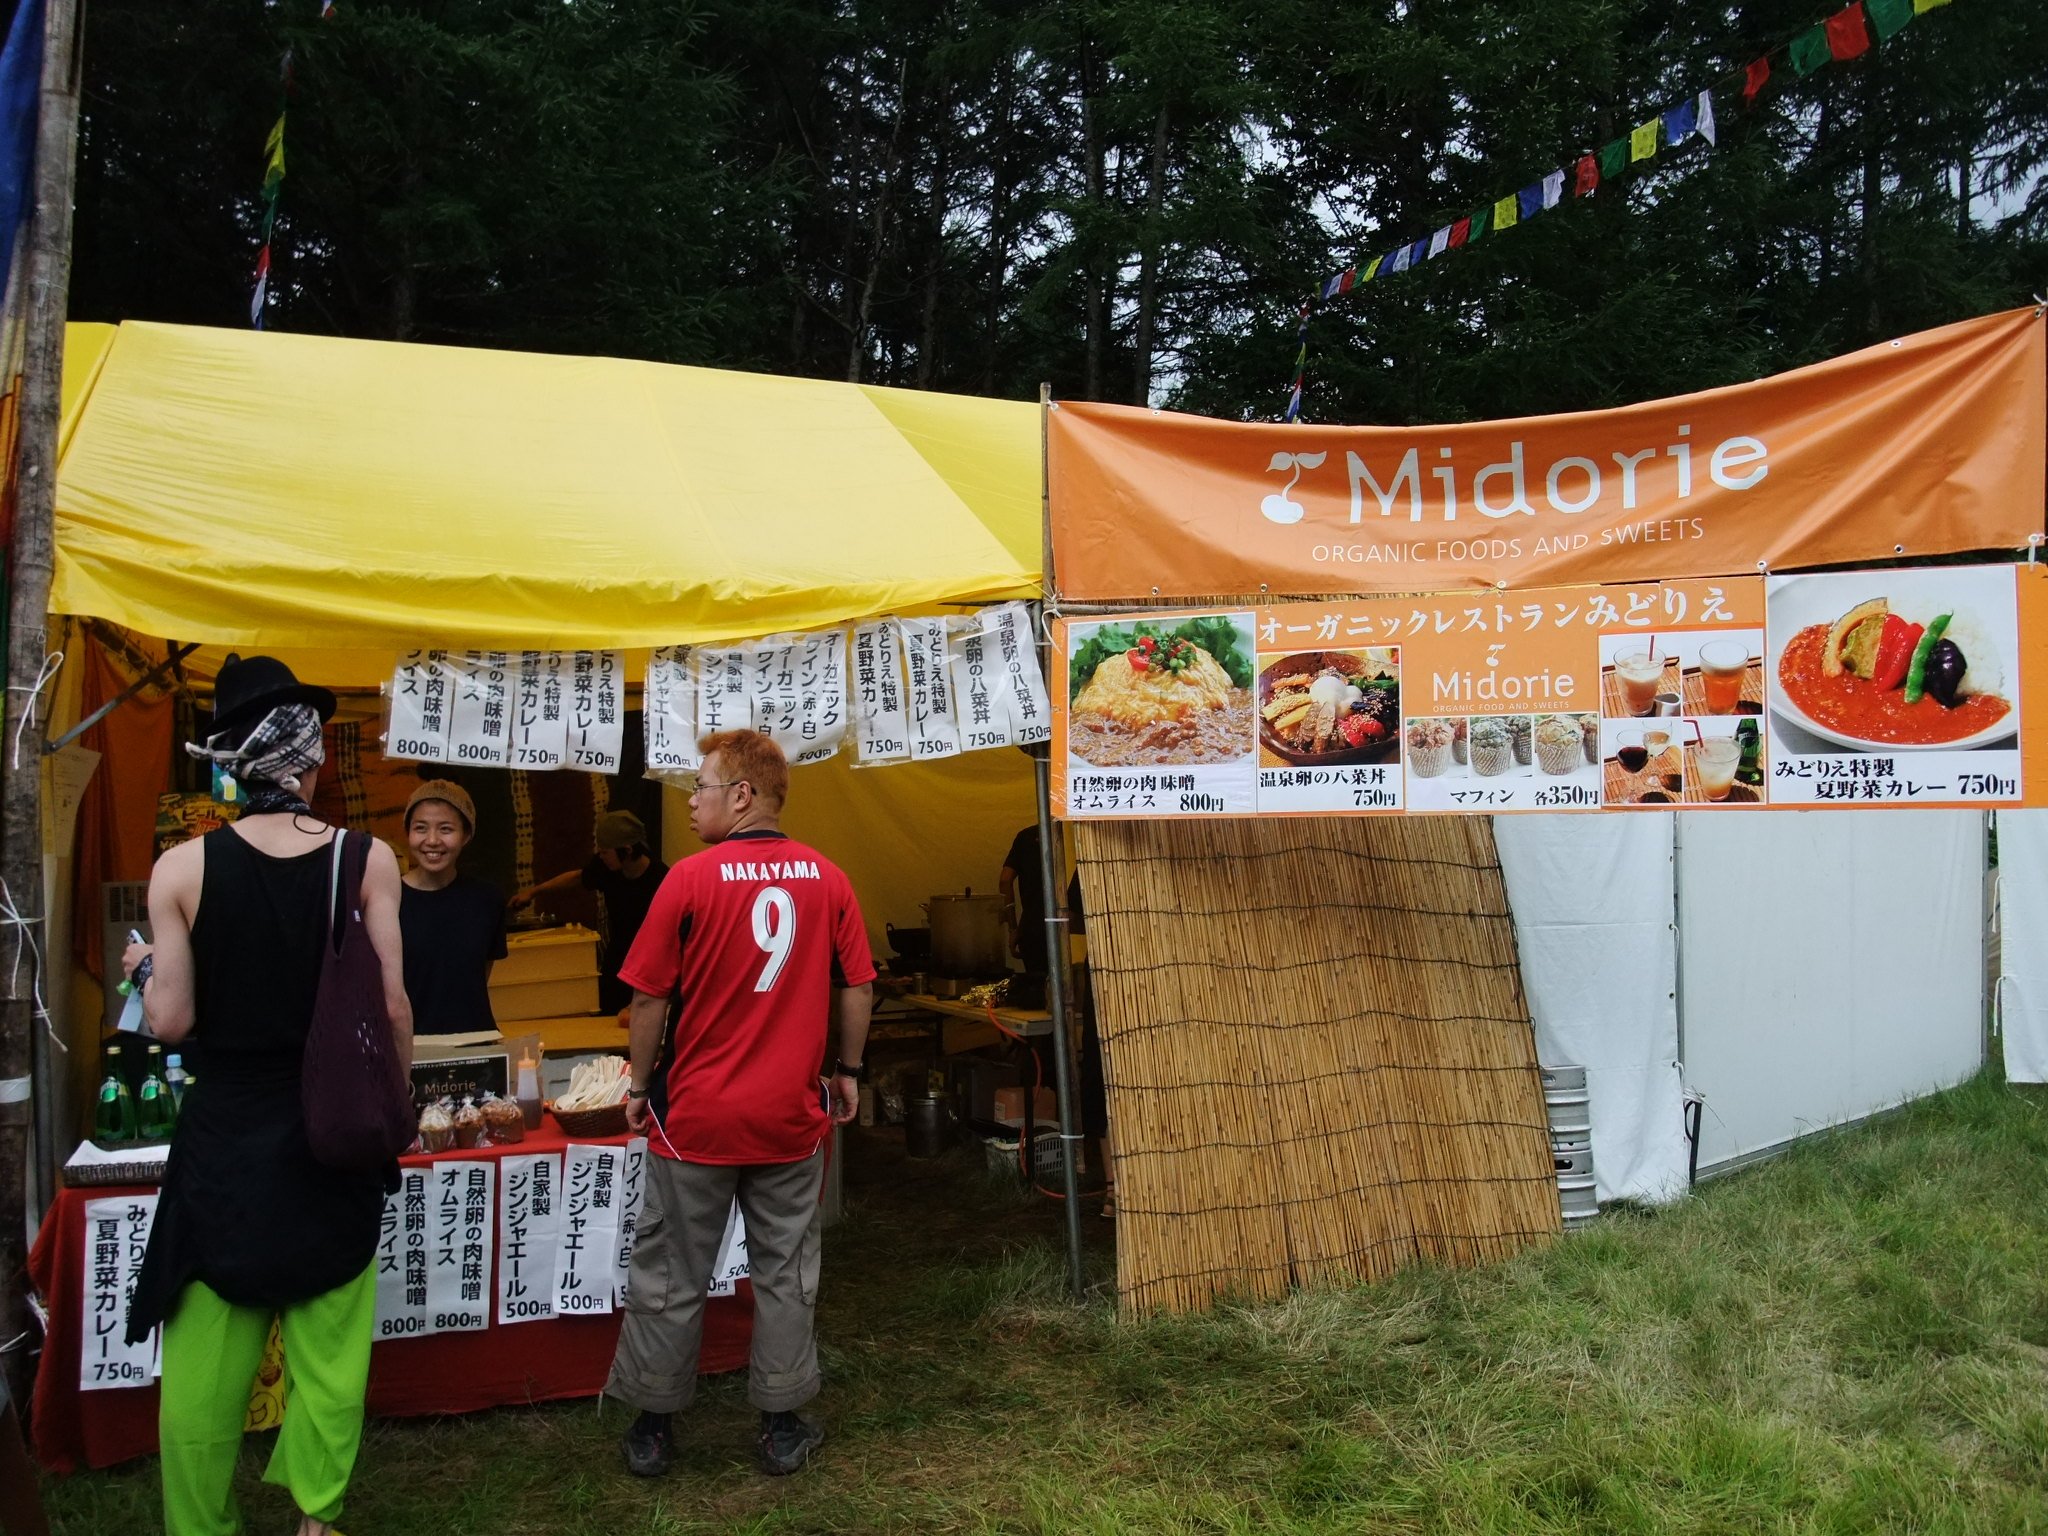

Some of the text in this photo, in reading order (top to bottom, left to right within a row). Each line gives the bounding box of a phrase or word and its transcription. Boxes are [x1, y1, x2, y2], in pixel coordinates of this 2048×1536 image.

[1346, 424, 1769, 524] Midorie
[1311, 517, 1704, 563] ORGANIC FOODS AND SWEETS
[1257, 586, 1735, 644] オーガニックレストランみどりえ
[998, 612, 1037, 721] 温泉卵の八菜丼
[543, 650, 562, 721] りえ特製
[777, 645, 797, 731] オーガニック
[821, 633, 841, 727] オーガニック
[1431, 668, 1575, 702] Midorie
[574, 650, 594, 747] 野菜カレー
[1432, 701, 1570, 713] ORGANIC FOOD AND SWEETS
[396, 739, 440, 758] 800円
[865, 739, 903, 754] 750円
[918, 740, 953, 754] 750円
[968, 731, 1006, 747] 750円
[457, 743, 501, 761] 800円
[517, 748, 559, 764] 750円
[574, 750, 615, 767] 750円
[654, 752, 692, 767] 500円
[1259, 767, 1386, 788] 温泉卵の八菜丼
[1775, 758, 1895, 778] みどりえ特製
[1072, 773, 1196, 793] 自然卵の肉味噌
[1814, 773, 2016, 800] 夏野菜カレー 750円
[1072, 793, 1224, 812] オムライス 800円
[1353, 788, 1397, 807] 750円
[1450, 784, 1599, 806] マフィン 各350円
[720, 860, 821, 882] NAKAYAMA
[751, 886, 797, 992] 9
[424, 1080, 477, 1095] Midorie
[532, 1160, 550, 1217] 自家製
[593, 1152, 615, 1209] 自家製
[437, 1168, 461, 1266] オムライス
[560, 1161, 594, 1290] ジンジャエール
[404, 1174, 427, 1307] 自然卵の肉味噌
[461, 1168, 487, 1302] 自然卵の肉味噌
[505, 1171, 529, 1298] ジンジャエール
[94, 1218, 121, 1359] 夏野菜カレー
[505, 1300, 551, 1318] 500円
[560, 1294, 604, 1310] 500円
[435, 1312, 482, 1329] 800円
[93, 1361, 145, 1382] 750円
